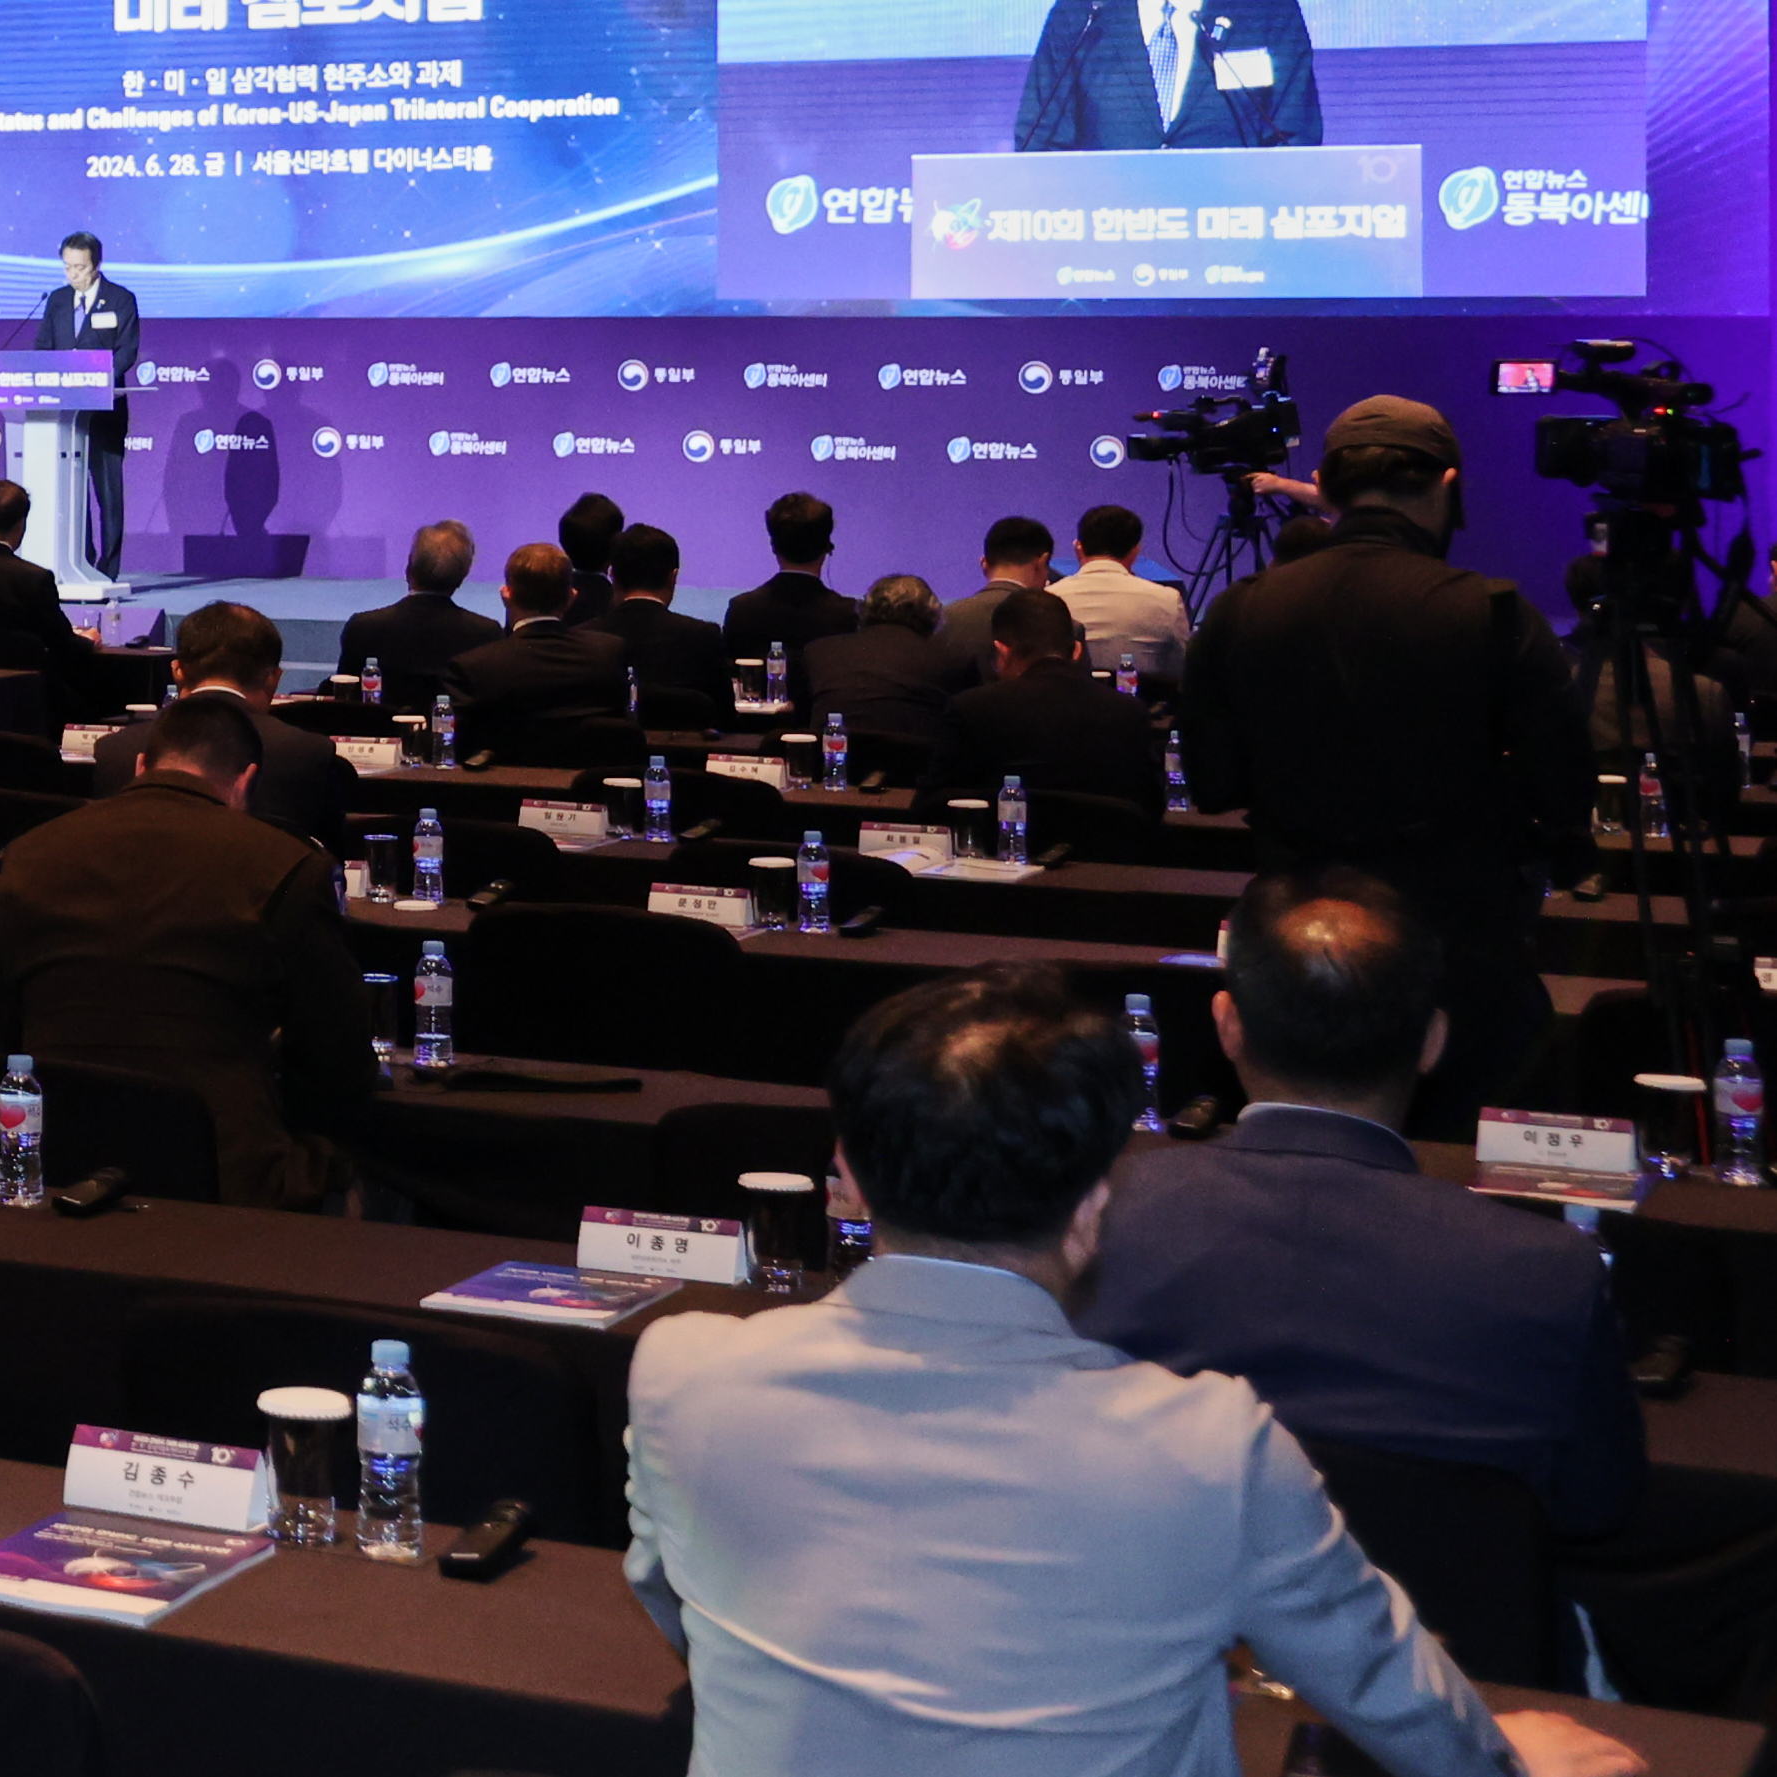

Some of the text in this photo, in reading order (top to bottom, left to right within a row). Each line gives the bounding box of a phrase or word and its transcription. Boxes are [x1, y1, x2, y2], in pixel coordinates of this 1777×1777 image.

[231, 64, 319, 96] 삼각협력
[323, 60, 412, 93] 현주소와
[415, 58, 463, 90] 과제
[47, 108, 84, 131] and
[87, 105, 194, 134] Challenges
[197, 103, 220, 126] of
[222, 98, 388, 130] Korea-US-Japan
[391, 94, 487, 122] Trilateral
[489, 92, 620, 124] Cooperation
[85, 145, 493, 179] 2024. 6. 28. 금 서울신라호텔 다이너스티홀
[1502, 169, 1589, 191] 연합뉴스
[822, 187, 913, 225] 연합
[1502, 190, 1649, 225] 동북아센
[988, 204, 1407, 242] 제10회 한반도 미래 심포지엄
[156, 365, 211, 383] 연합뉴스
[512, 366, 571, 385] 연합뉴스
[654, 367, 696, 384] 통일부
[901, 366, 967, 387] 연합뉴스
[1058, 368, 1105, 386] 통일부
[214, 434, 269, 450] 연합뉴스
[345, 434, 385, 450] 통일부
[575, 436, 635, 455] 연합뉴스
[719, 437, 762, 455] 통일부
[972, 441, 1038, 460] 연합뉴스
